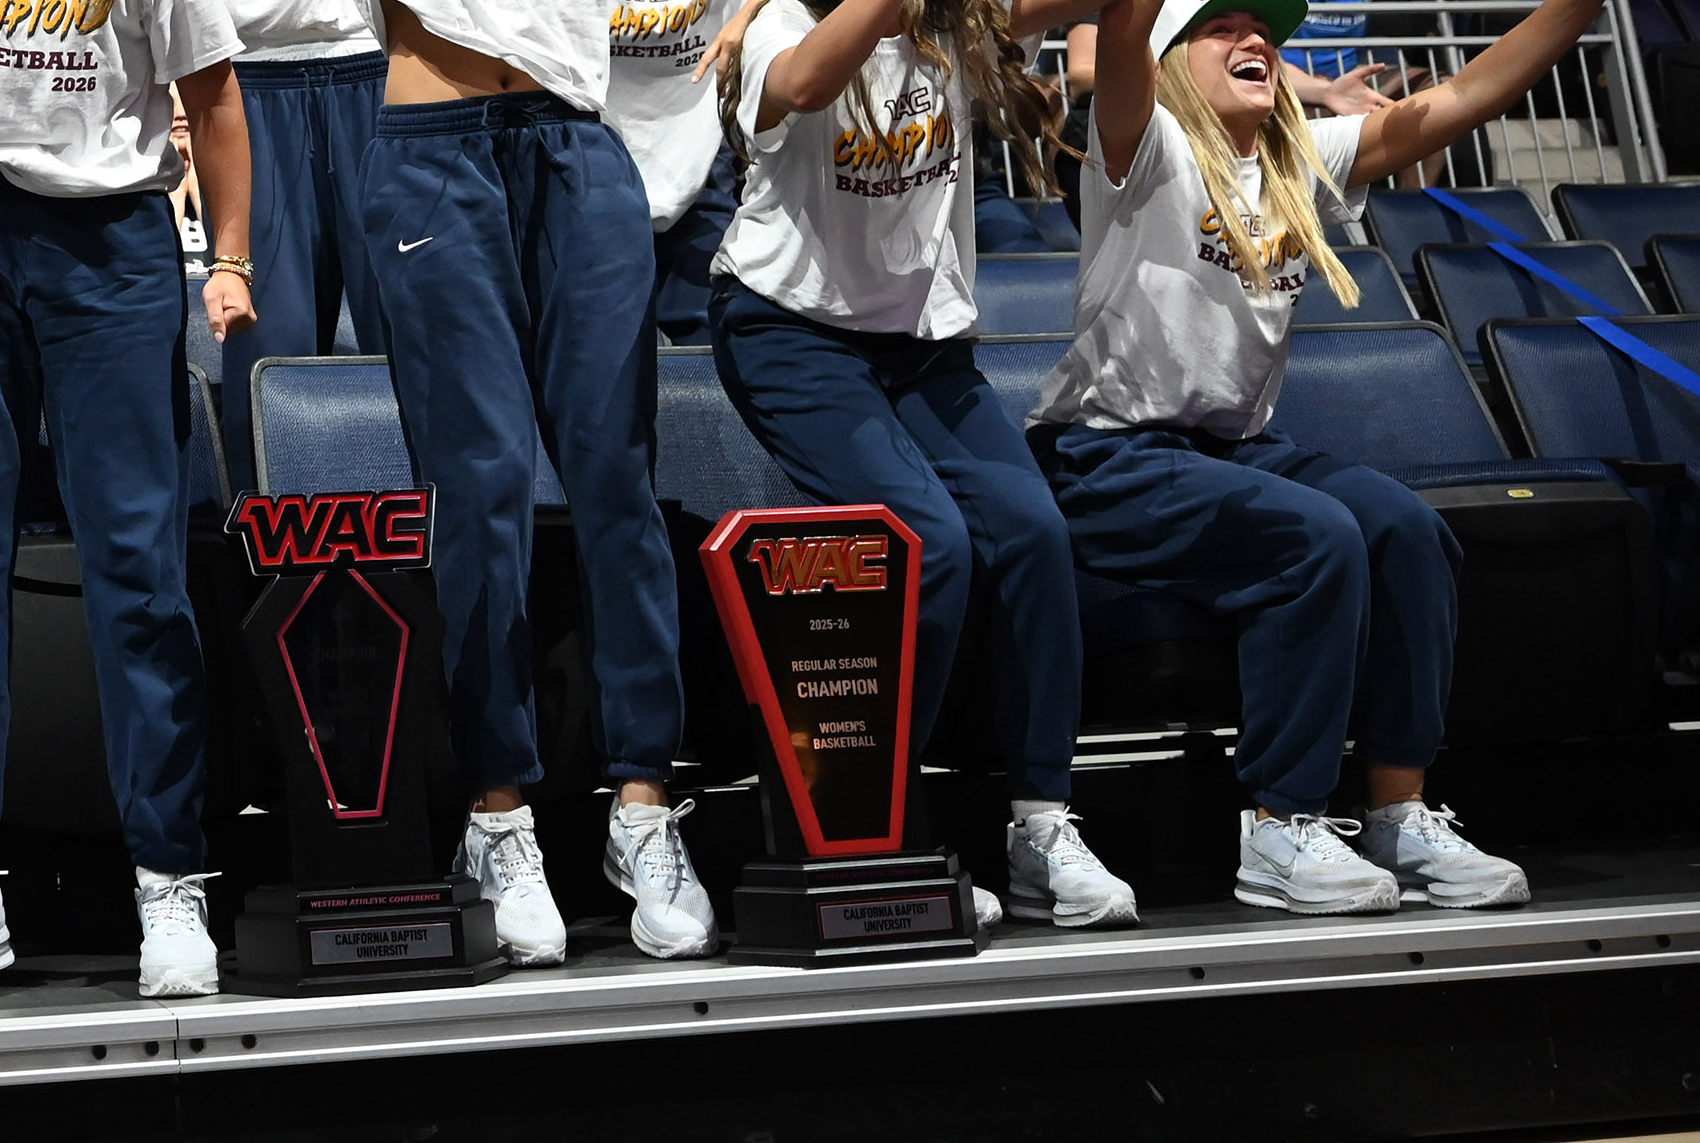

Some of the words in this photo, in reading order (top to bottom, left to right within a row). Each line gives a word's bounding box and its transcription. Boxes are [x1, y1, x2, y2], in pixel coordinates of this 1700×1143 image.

[51, 76, 97, 92] 2026
[237, 491, 428, 565] WAC
[747, 535, 888, 595] WAC
[809, 618, 850, 631] 2025-26
[791, 659, 837, 672] REGULAR
[838, 657, 877, 669] SEASON
[797, 678, 879, 698] CHAMPION
[819, 720, 866, 734] WOMEN'S
[813, 735, 876, 750] BASKETBALL
[310, 899, 348, 908] WESTERN
[350, 896, 387, 905] ATHLETIC
[389, 893, 441, 903] CONFERENCE
[843, 905, 893, 920] CALIFORNIA
[895, 903, 929, 916] BAPTIST
[864, 918, 912, 932] UNIVERSITY
[335, 930, 389, 946] CALIFORNIA
[391, 929, 428, 942] BAPTIST
[357, 944, 408, 958] UNIVERSITY
